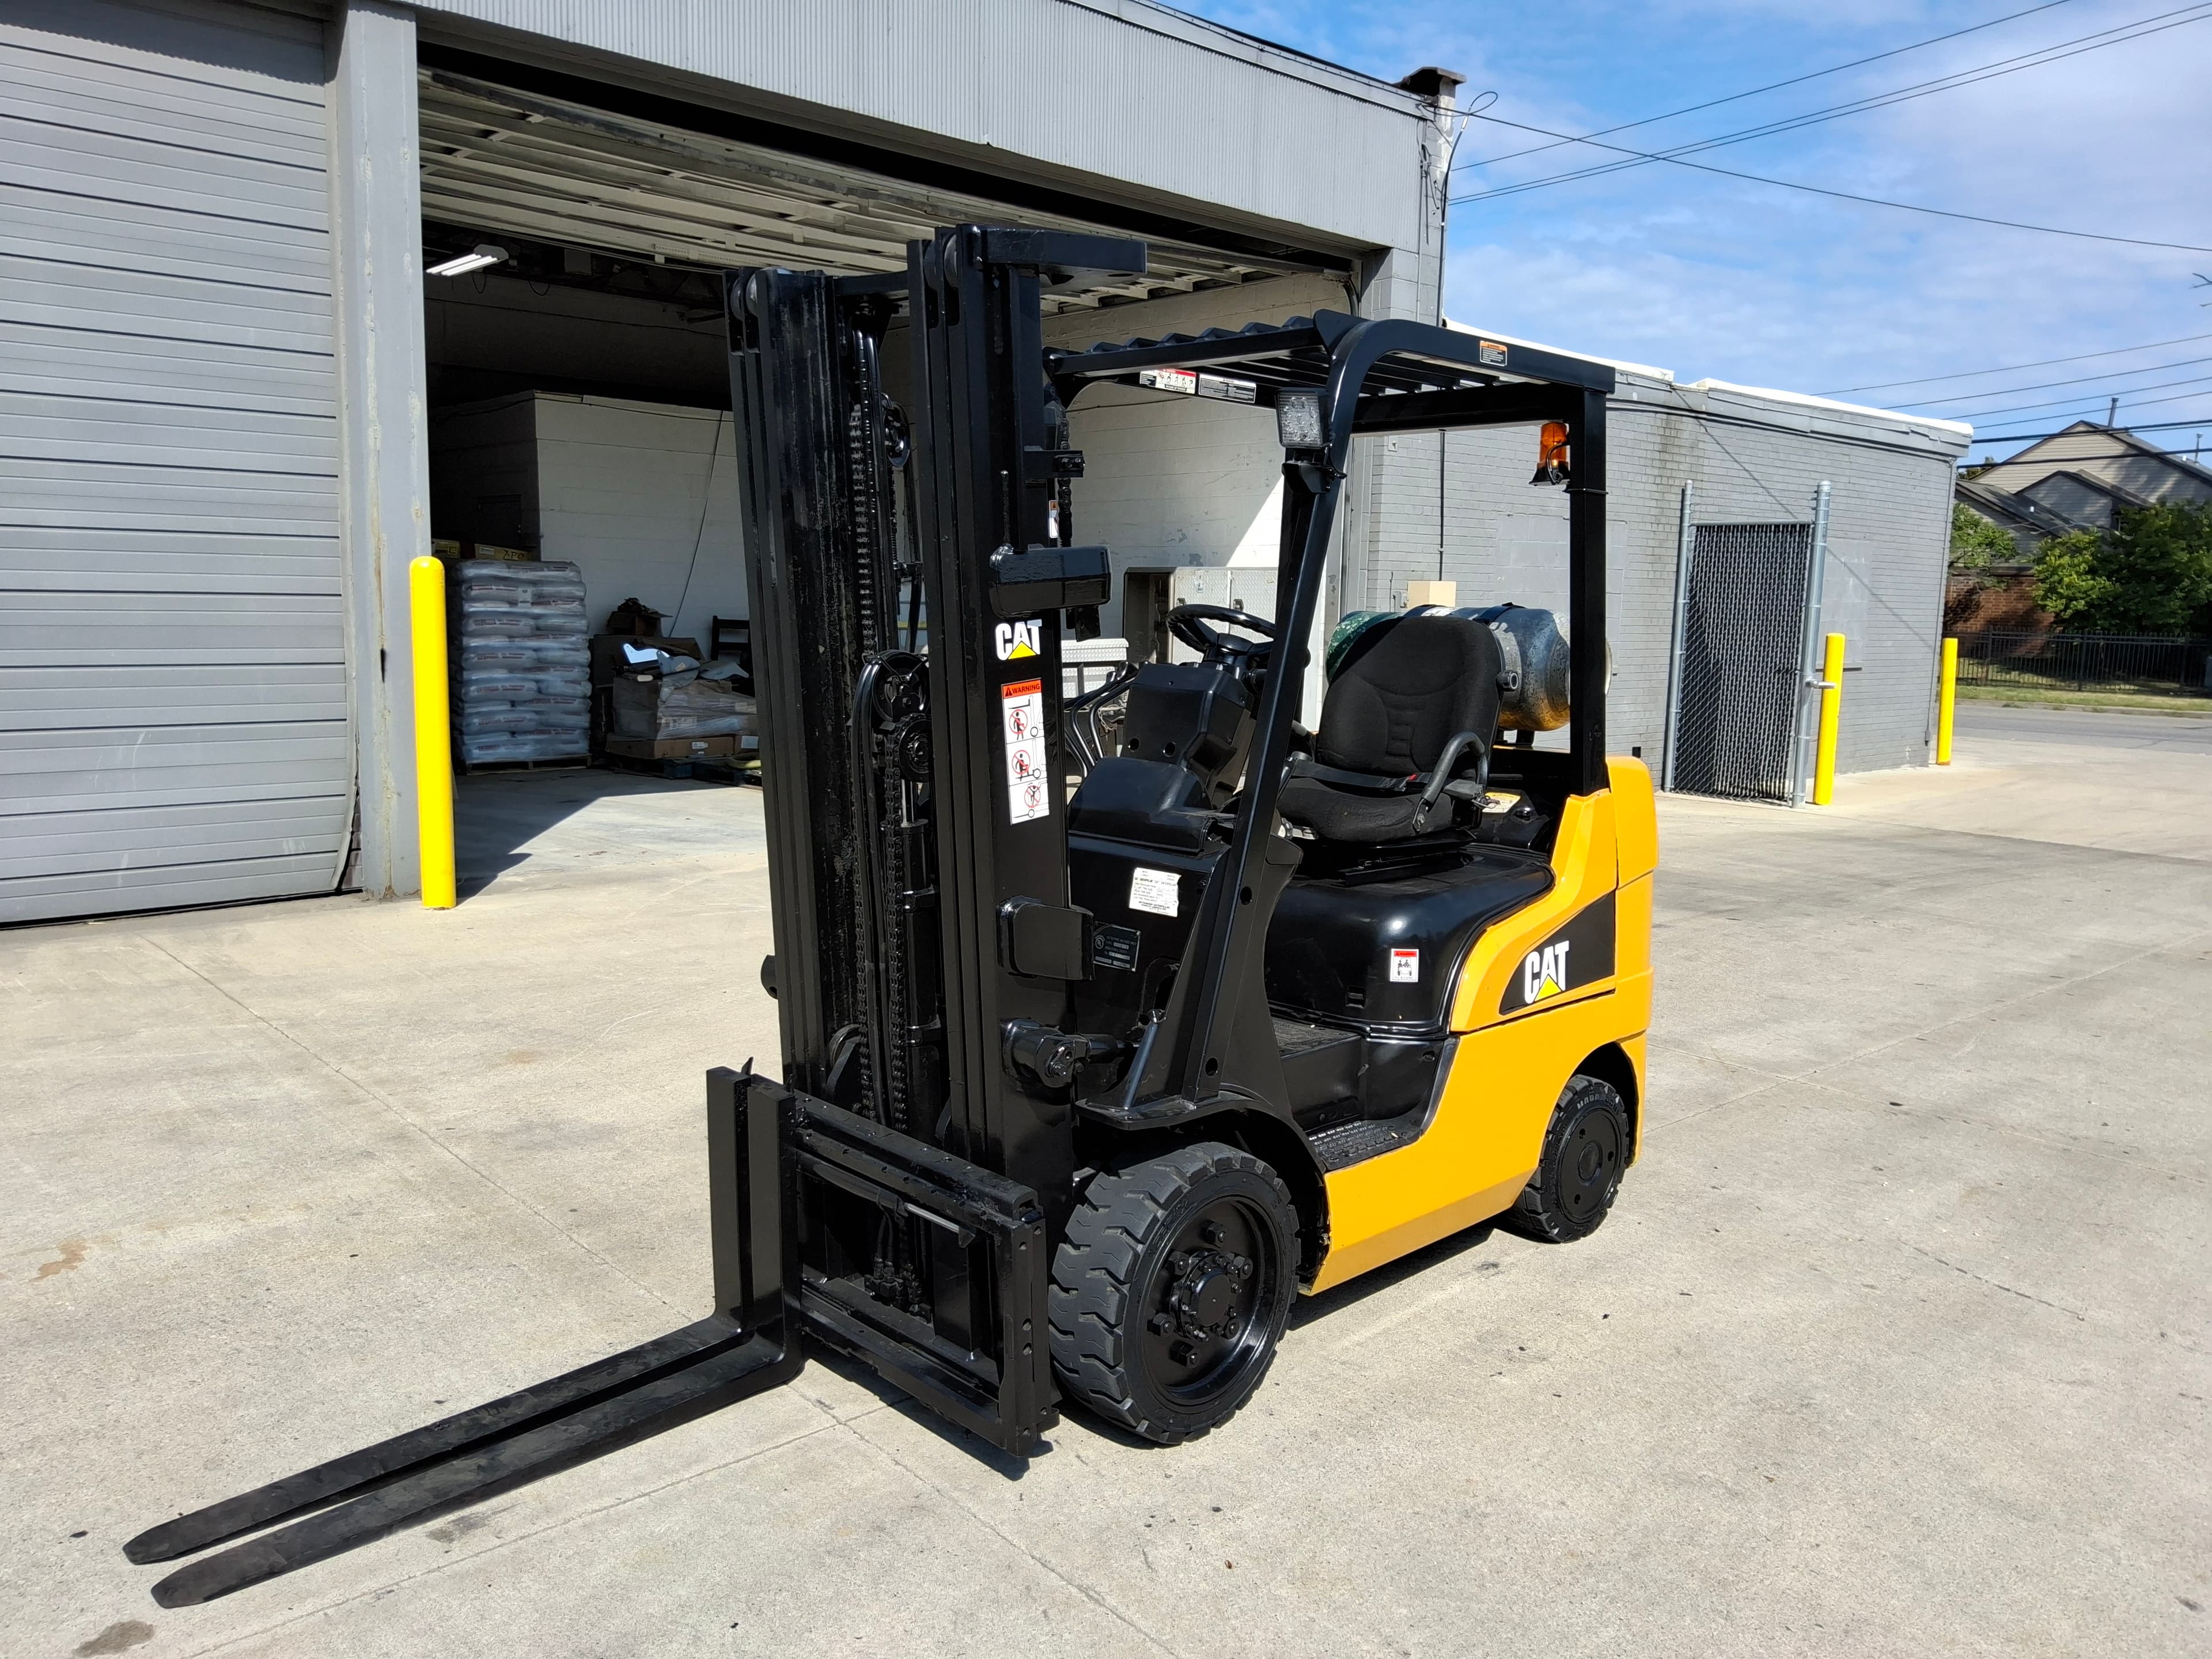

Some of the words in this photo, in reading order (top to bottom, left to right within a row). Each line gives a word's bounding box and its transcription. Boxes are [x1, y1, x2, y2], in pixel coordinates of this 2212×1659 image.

[995, 619, 1042, 661] CAT
[1013, 684, 1040, 694] WARNING
[1524, 940, 1569, 1004] CAT
